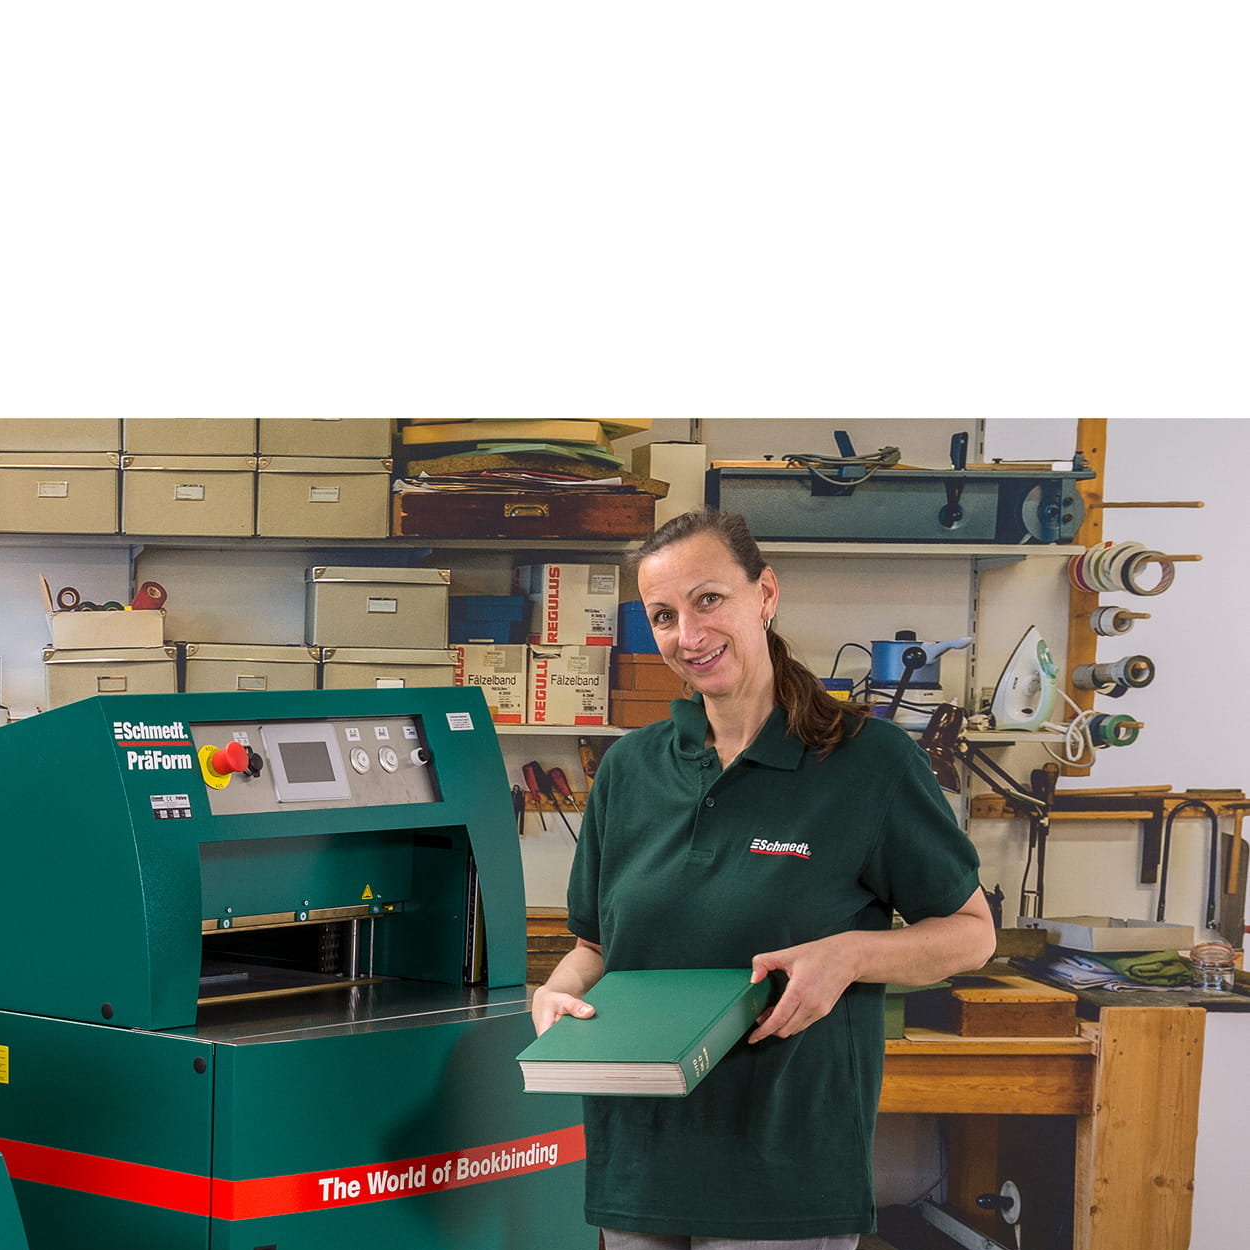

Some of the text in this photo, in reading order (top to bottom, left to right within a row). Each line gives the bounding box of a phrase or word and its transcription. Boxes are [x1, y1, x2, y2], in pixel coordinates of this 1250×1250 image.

[547, 566, 561, 643] REGULUS
[468, 674, 517, 686] Fälzelband
[534, 660, 548, 722] REGULU
[550, 674, 600, 686] Fälzelband
[127, 750, 192, 771] PräForm
[318, 1142, 559, 1202] The World of Bookbinding
